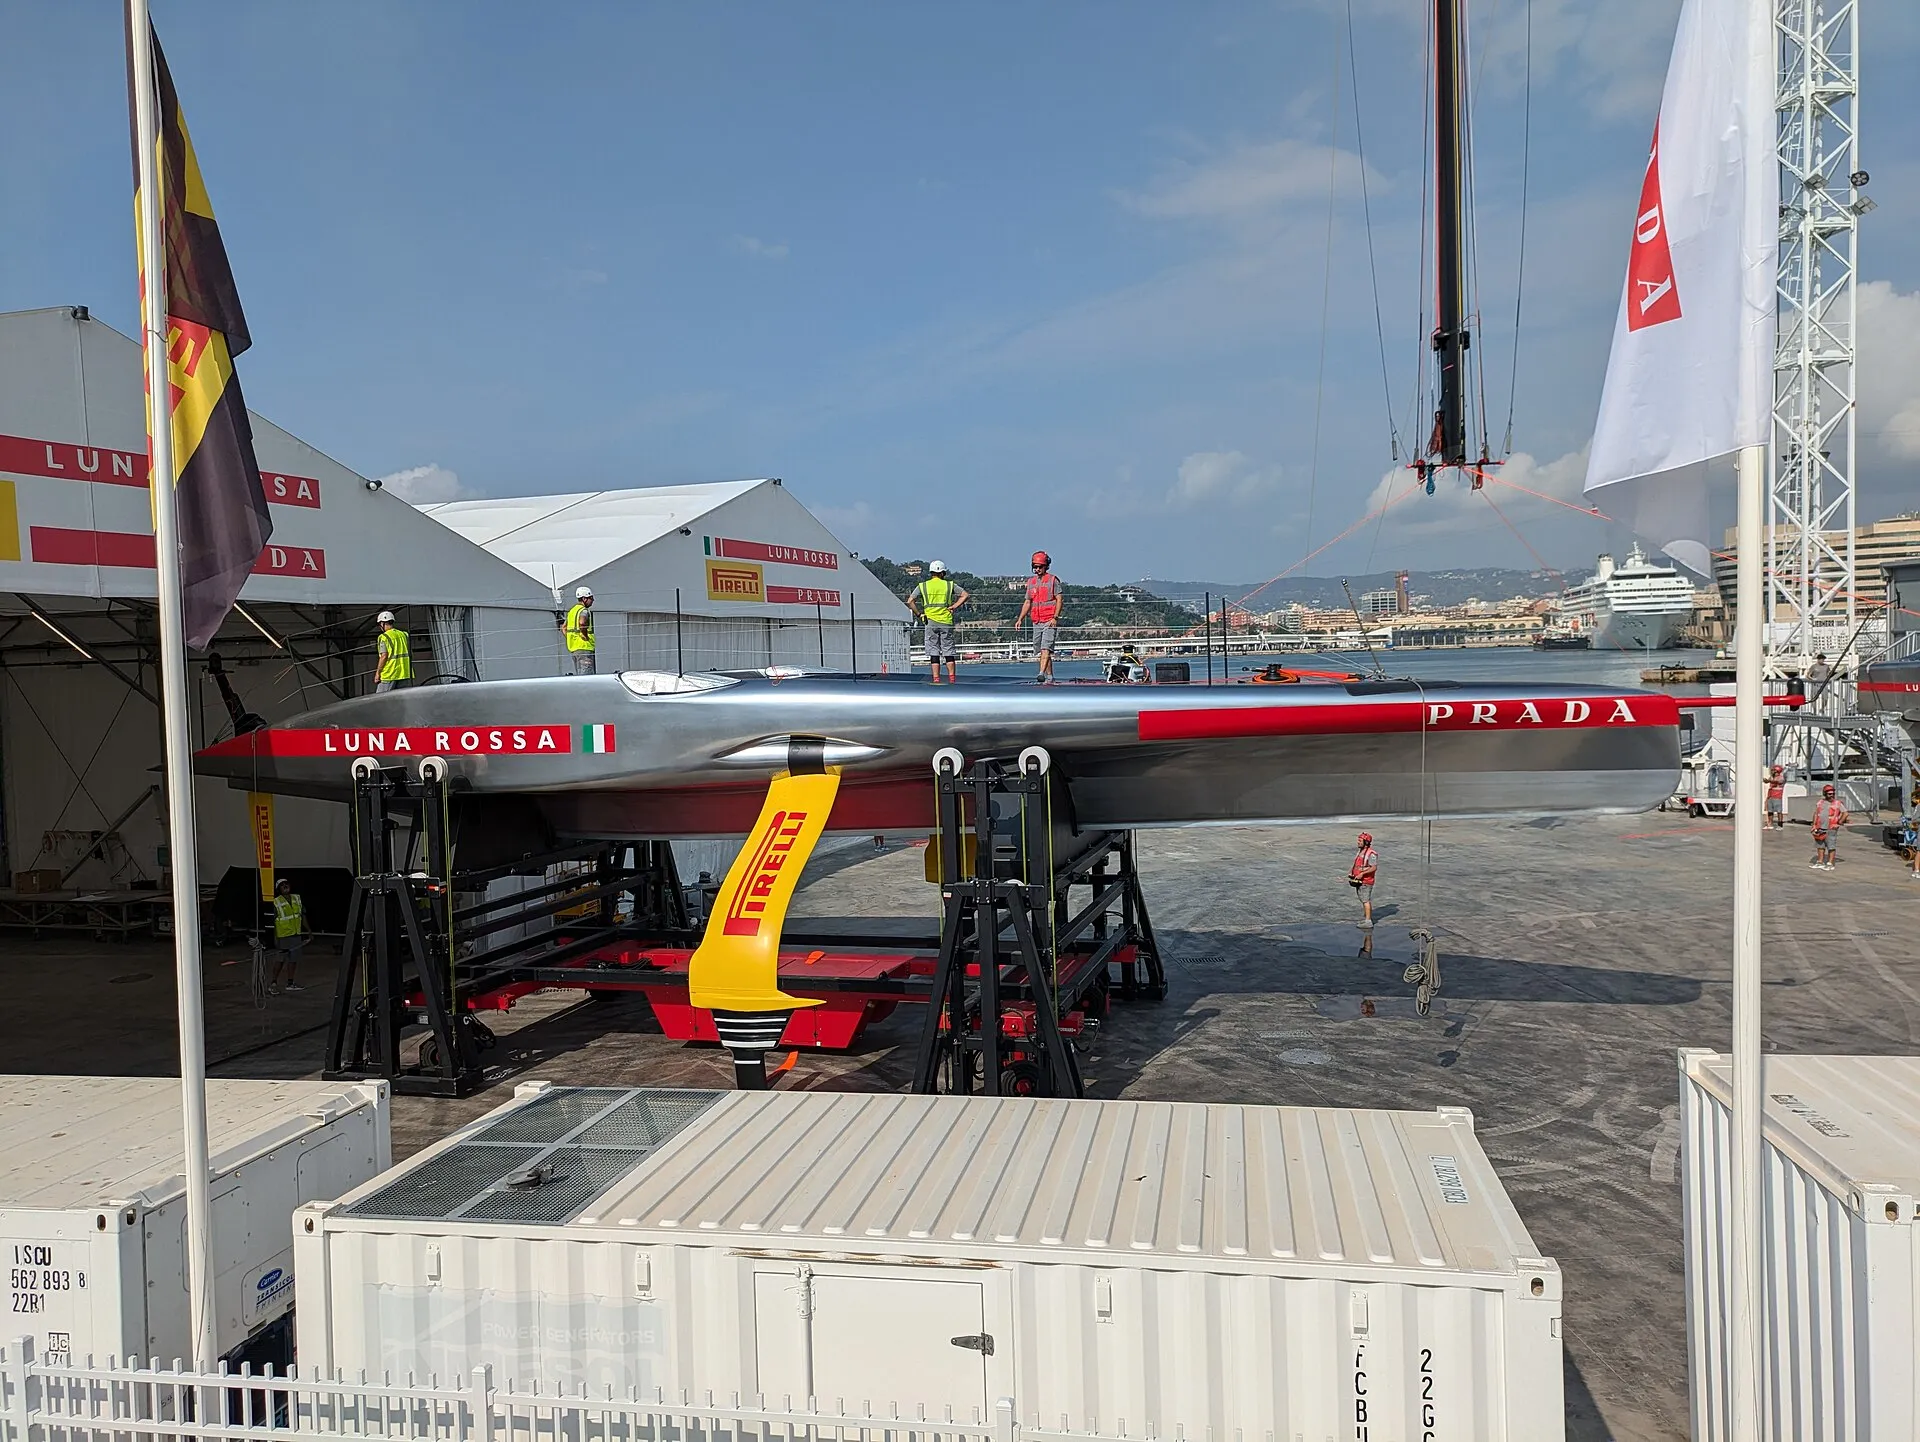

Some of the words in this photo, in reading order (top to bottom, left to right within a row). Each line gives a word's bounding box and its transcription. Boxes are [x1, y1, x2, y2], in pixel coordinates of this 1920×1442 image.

[46, 445, 148, 478] LUN
[768, 546, 798, 561] LUNA
[804, 551, 837, 566] ROSSA
[712, 568, 759, 595] PIRELLI
[797, 588, 839, 602] PRADA
[1427, 699, 1637, 726] PRADA
[324, 731, 412, 752] LUNA
[436, 729, 557, 751] ROSSA
[256, 806, 272, 868] PIRELLI
[722, 811, 807, 936] PIRELLI
[14, 1245, 51, 1266] ISCU
[11, 1268, 37, 1290] 562
[43, 1270, 70, 1290] 893
[78, 1272, 86, 1288] 8
[256, 1273, 295, 1301] TRANSICOL
[259, 1270, 281, 1288] Carrier
[12, 1292, 45, 1313] 22R1
[483, 1322, 539, 1340] POWER
[546, 1327, 655, 1346] GENERATORS
